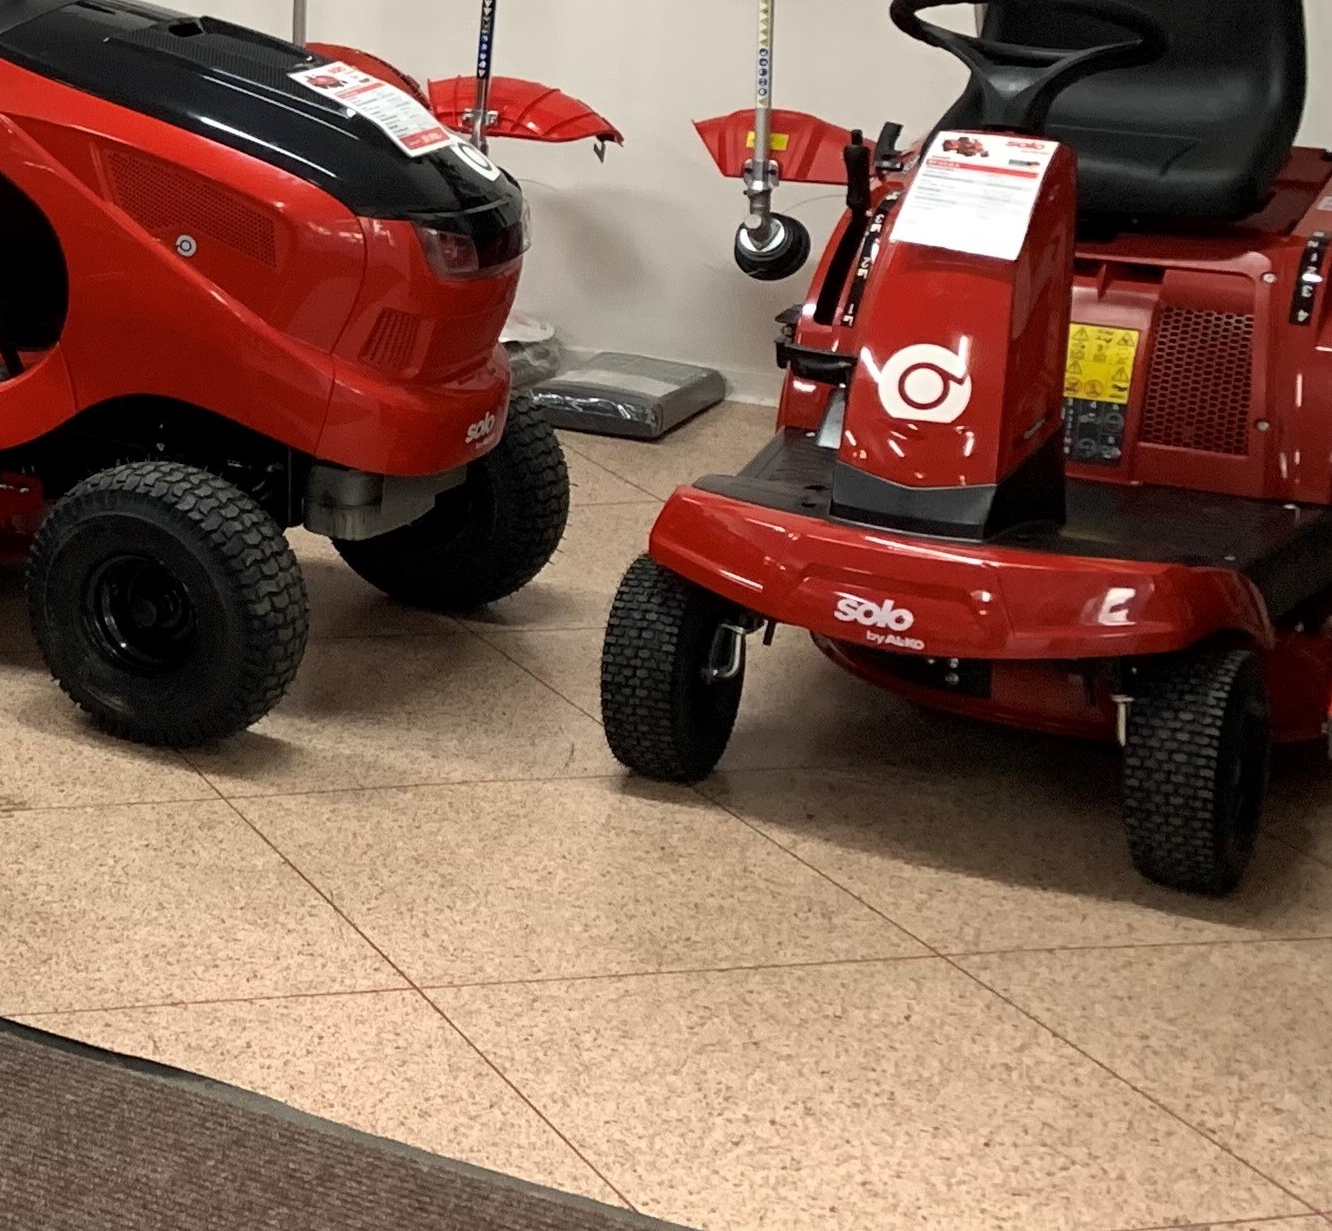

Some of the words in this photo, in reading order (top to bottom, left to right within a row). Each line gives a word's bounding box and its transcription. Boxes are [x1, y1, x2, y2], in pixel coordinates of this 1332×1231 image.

[465, 411, 496, 444] solo
[833, 598, 914, 631] solo
[865, 630, 884, 644] by
